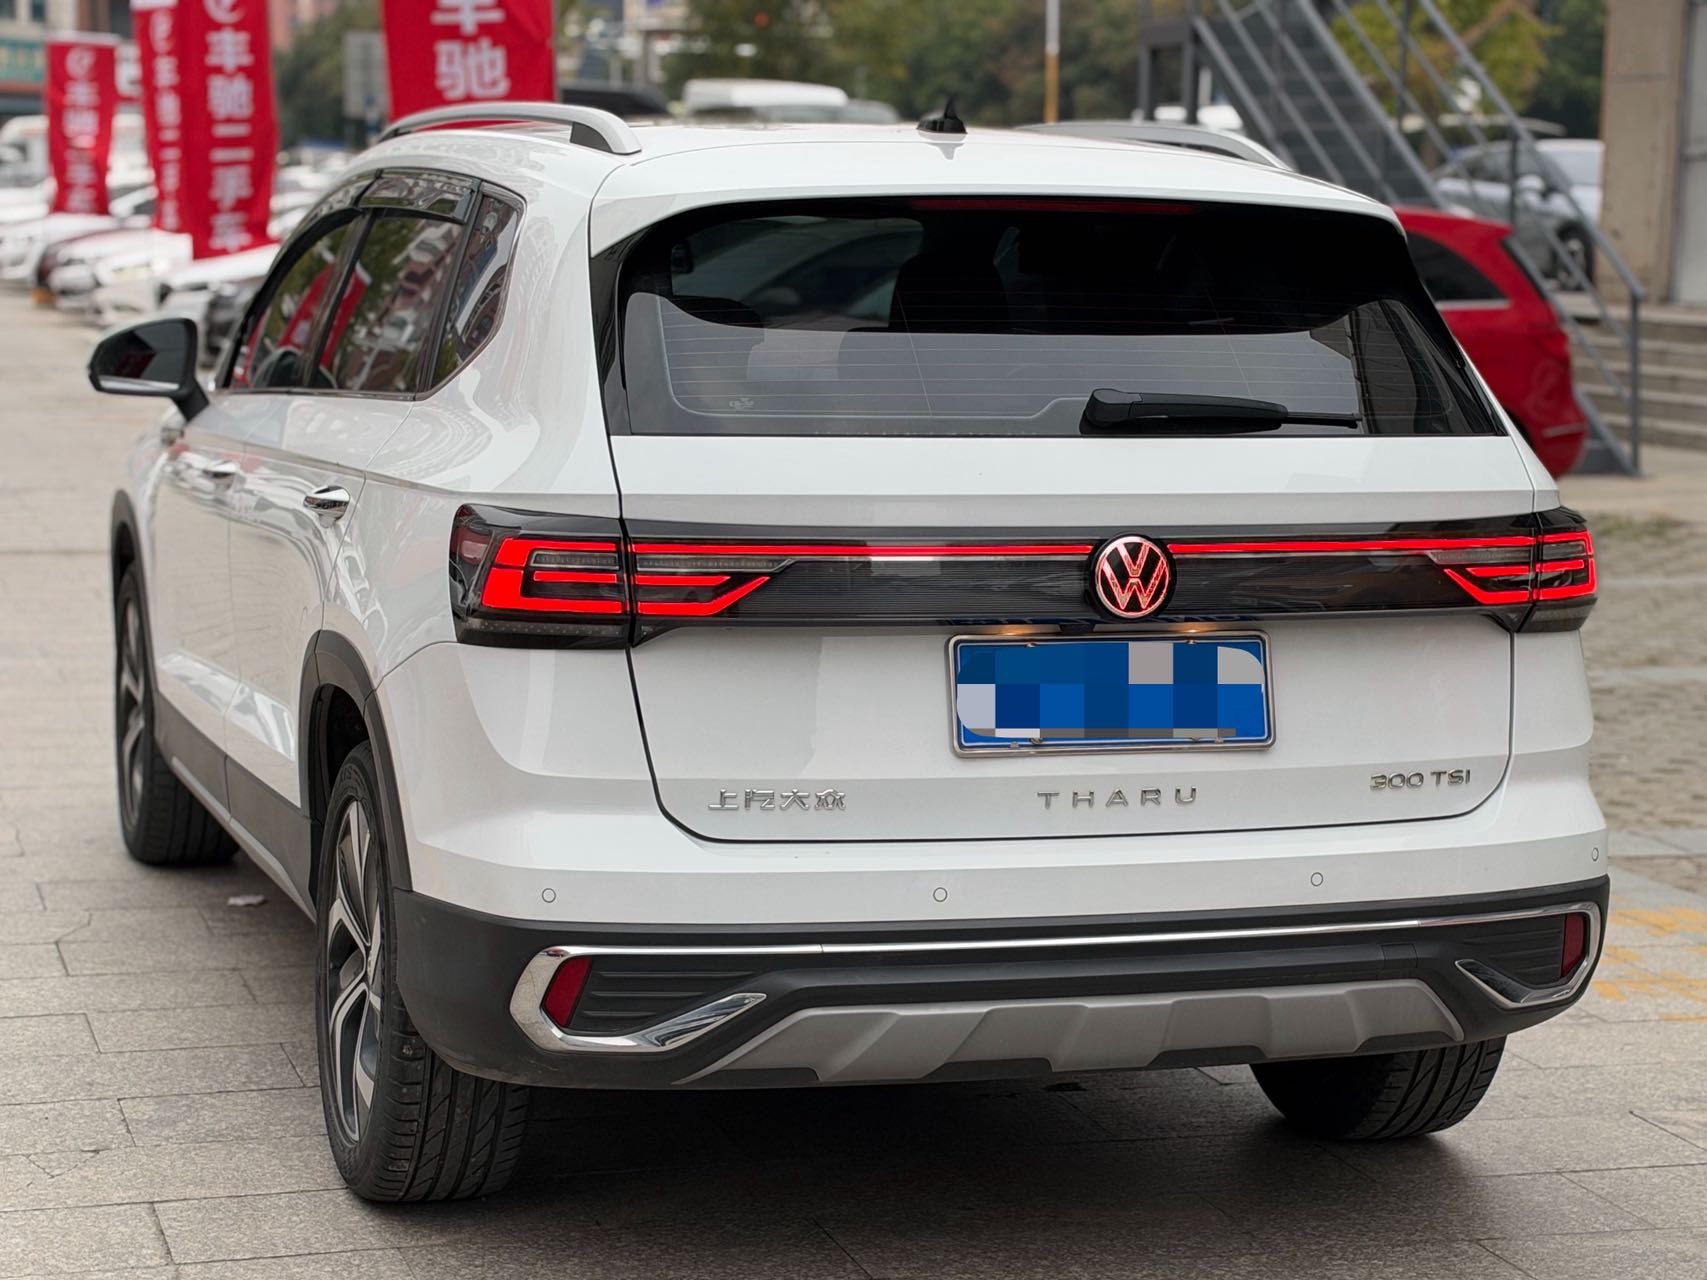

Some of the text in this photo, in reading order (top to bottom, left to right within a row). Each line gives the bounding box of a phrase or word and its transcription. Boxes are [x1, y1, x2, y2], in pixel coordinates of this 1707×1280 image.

[1101, 541, 1166, 610] VW
[1370, 769, 1471, 790] 300 TSI
[708, 788, 846, 811] 上汽大众
[1036, 786, 1197, 810] THARU
